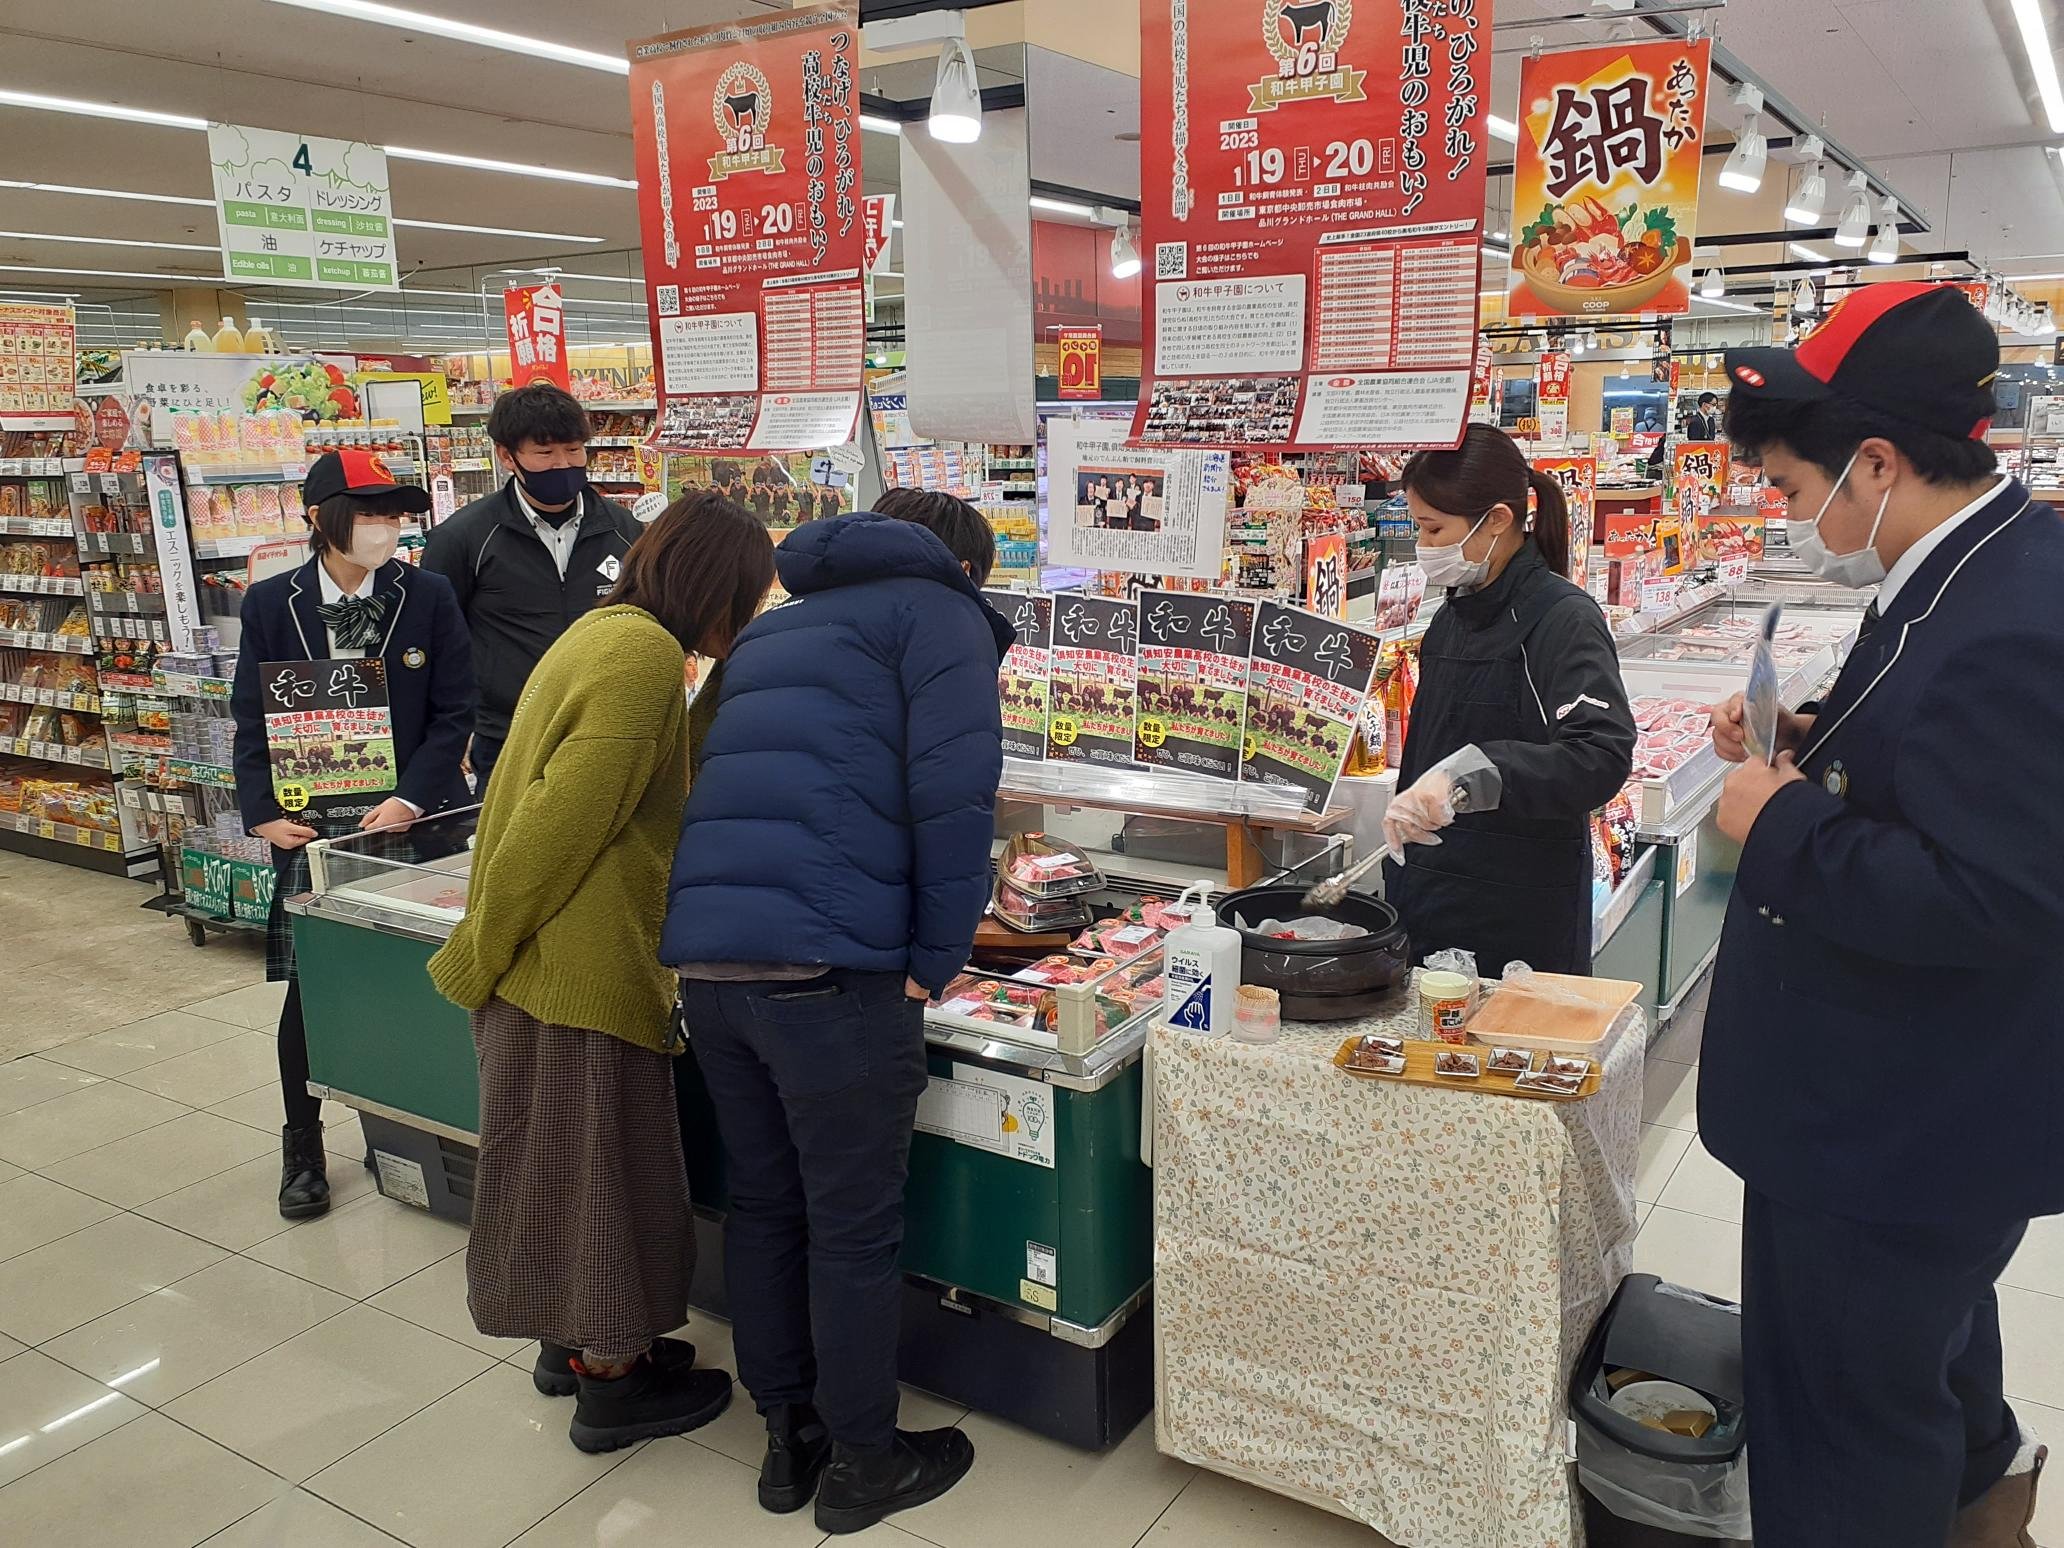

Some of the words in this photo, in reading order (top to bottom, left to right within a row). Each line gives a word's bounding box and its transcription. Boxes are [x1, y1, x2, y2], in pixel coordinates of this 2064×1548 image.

[1278, 41, 1336, 79] 第6回
[1271, 77, 1343, 97] 和牛甲子園
[1663, 58, 1696, 151] あったか
[1228, 120, 1249, 130] 開催日
[725, 124, 765, 154] 第6回
[1220, 131, 1259, 150] 2023
[1542, 77, 1664, 198] 鍋
[293, 143, 312, 176] 4
[722, 153, 770, 169] 和牛甲子園
[1234, 166, 1242, 186] 1
[1247, 148, 1285, 185] 19
[1298, 153, 1307, 175] THU
[1325, 138, 1374, 178] 20
[1382, 146, 1391, 165] FRI
[236, 182, 291, 201] パスタ
[316, 189, 382, 211] ドレッシング
[1221, 194, 1241, 203] 1日目
[1316, 185, 1338, 194] 2日目
[693, 197, 718, 211] 2023
[236, 208, 256, 218] pasta
[712, 210, 737, 239] 19
[761, 203, 793, 235] 20
[1221, 209, 1250, 218] 開催場所
[1259, 215, 1329, 228] 品川グランドホール
[1349, 209, 1374, 220] GRAND
[316, 216, 346, 228] dressing
[261, 234, 277, 250] 油
[320, 239, 386, 259] ケチャップ
[232, 259, 255, 269] Edible
[1196, 253, 1259, 263] 大会の様子はこちらでも
[323, 266, 350, 277] ketchup
[1193, 283, 1284, 298] 和牛甲子園について
[1582, 300, 1610, 309] COOP
[532, 286, 562, 362] 合格
[685, 319, 743, 331] 和牛甲子園について
[1553, 354, 1570, 382] 合格
[145, 383, 209, 393] 食卓を彩る、
[1683, 453, 1713, 479] 鍋
[1728, 565, 1744, 577] 88
[166, 531, 190, 648] エスニックを楽しもう！
[1314, 555, 1340, 617] 鍋
[1656, 592, 1671, 603] 138
[1061, 603, 1136, 654] 和牛
[1148, 600, 1236, 653] 和牛
[1262, 615, 1353, 680] 和牛
[1073, 662, 1098, 672] 大切に
[1161, 660, 1188, 672] 大切に
[1198, 663, 1233, 680] 育てました
[269, 664, 368, 708] 和牛
[1266, 676, 1293, 692] 大切に
[1302, 686, 1342, 714] 育てました
[292, 723, 321, 735] 大切に
[332, 720, 375, 733] 育てました
[1055, 721, 1073, 732] 数量
[1143, 721, 1161, 733] 数量
[1054, 732, 1072, 743] 限定
[1143, 733, 1161, 745] 限定
[283, 787, 303, 797] 数量
[284, 798, 304, 808] 限定
[1171, 956, 1199, 968] ウイルス
